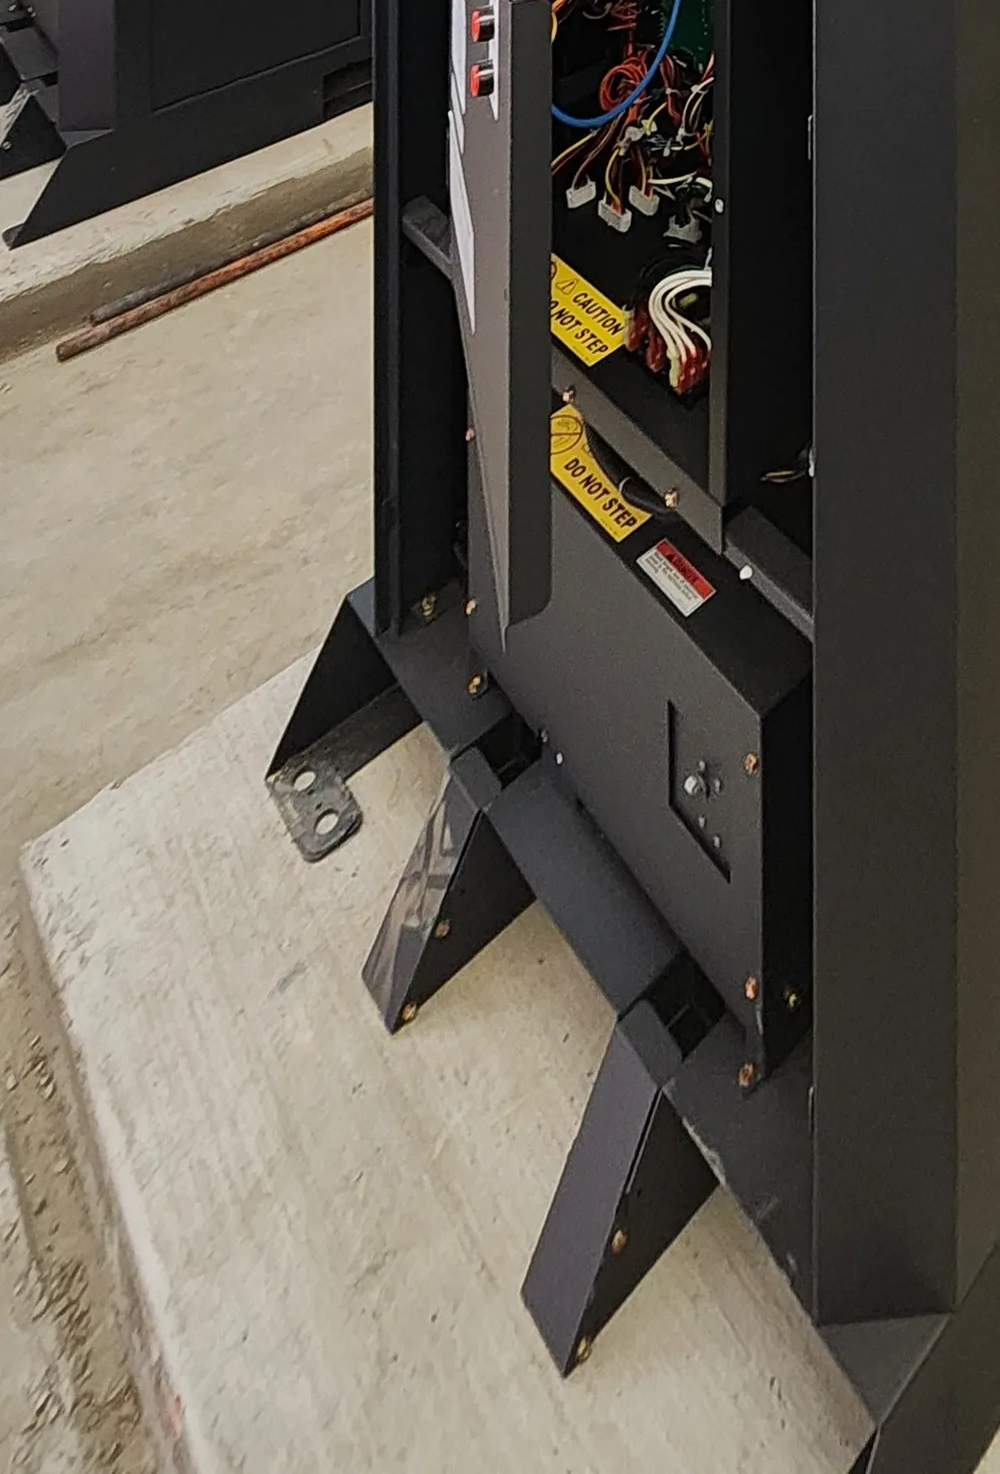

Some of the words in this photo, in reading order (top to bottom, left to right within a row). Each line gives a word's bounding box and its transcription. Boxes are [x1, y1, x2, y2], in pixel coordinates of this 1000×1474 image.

[551, 308, 582, 330] NOT
[574, 328, 609, 354] STEP
[572, 292, 625, 336] CAUTION
[563, 457, 587, 478] DO
[578, 473, 610, 501] NOT
[602, 497, 638, 528] STEP
